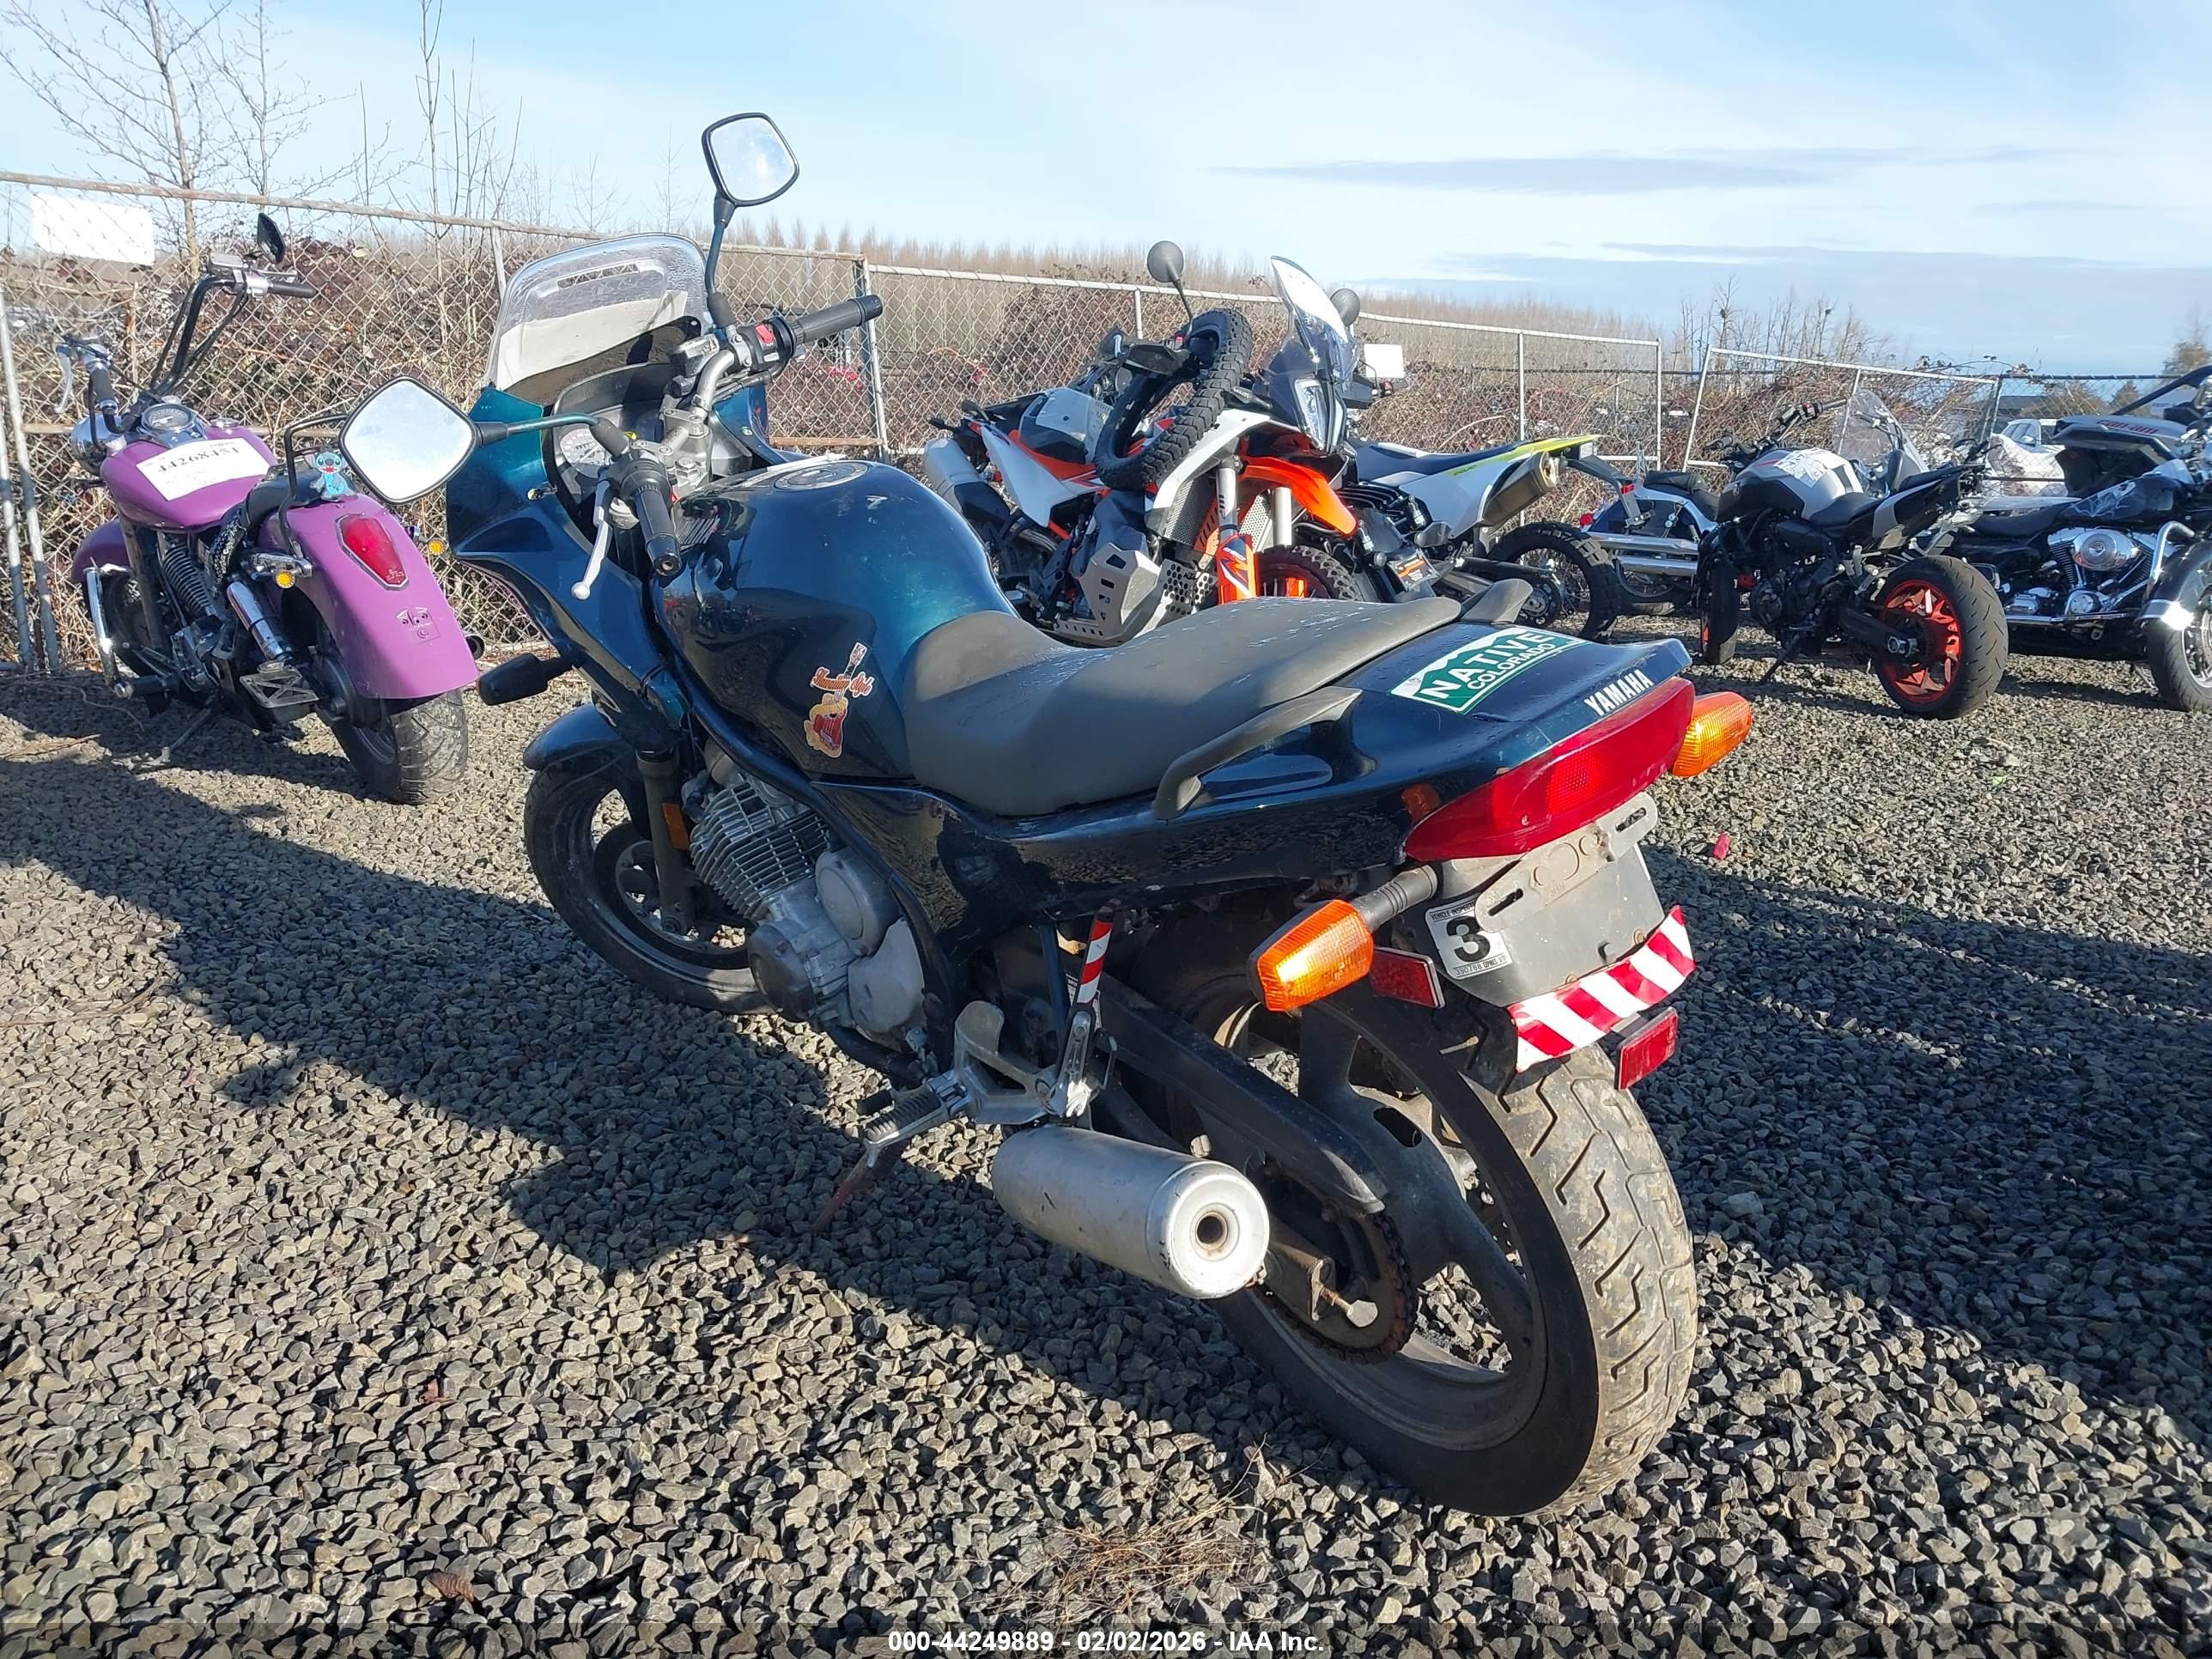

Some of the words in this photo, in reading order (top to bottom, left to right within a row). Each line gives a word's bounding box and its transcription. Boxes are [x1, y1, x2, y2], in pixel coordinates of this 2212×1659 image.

[1419, 632, 1555, 700] NATIVE
[1467, 642, 1556, 690] COLORADO
[1583, 669, 1655, 716] YAMAHA
[1446, 915, 1491, 962] 3
